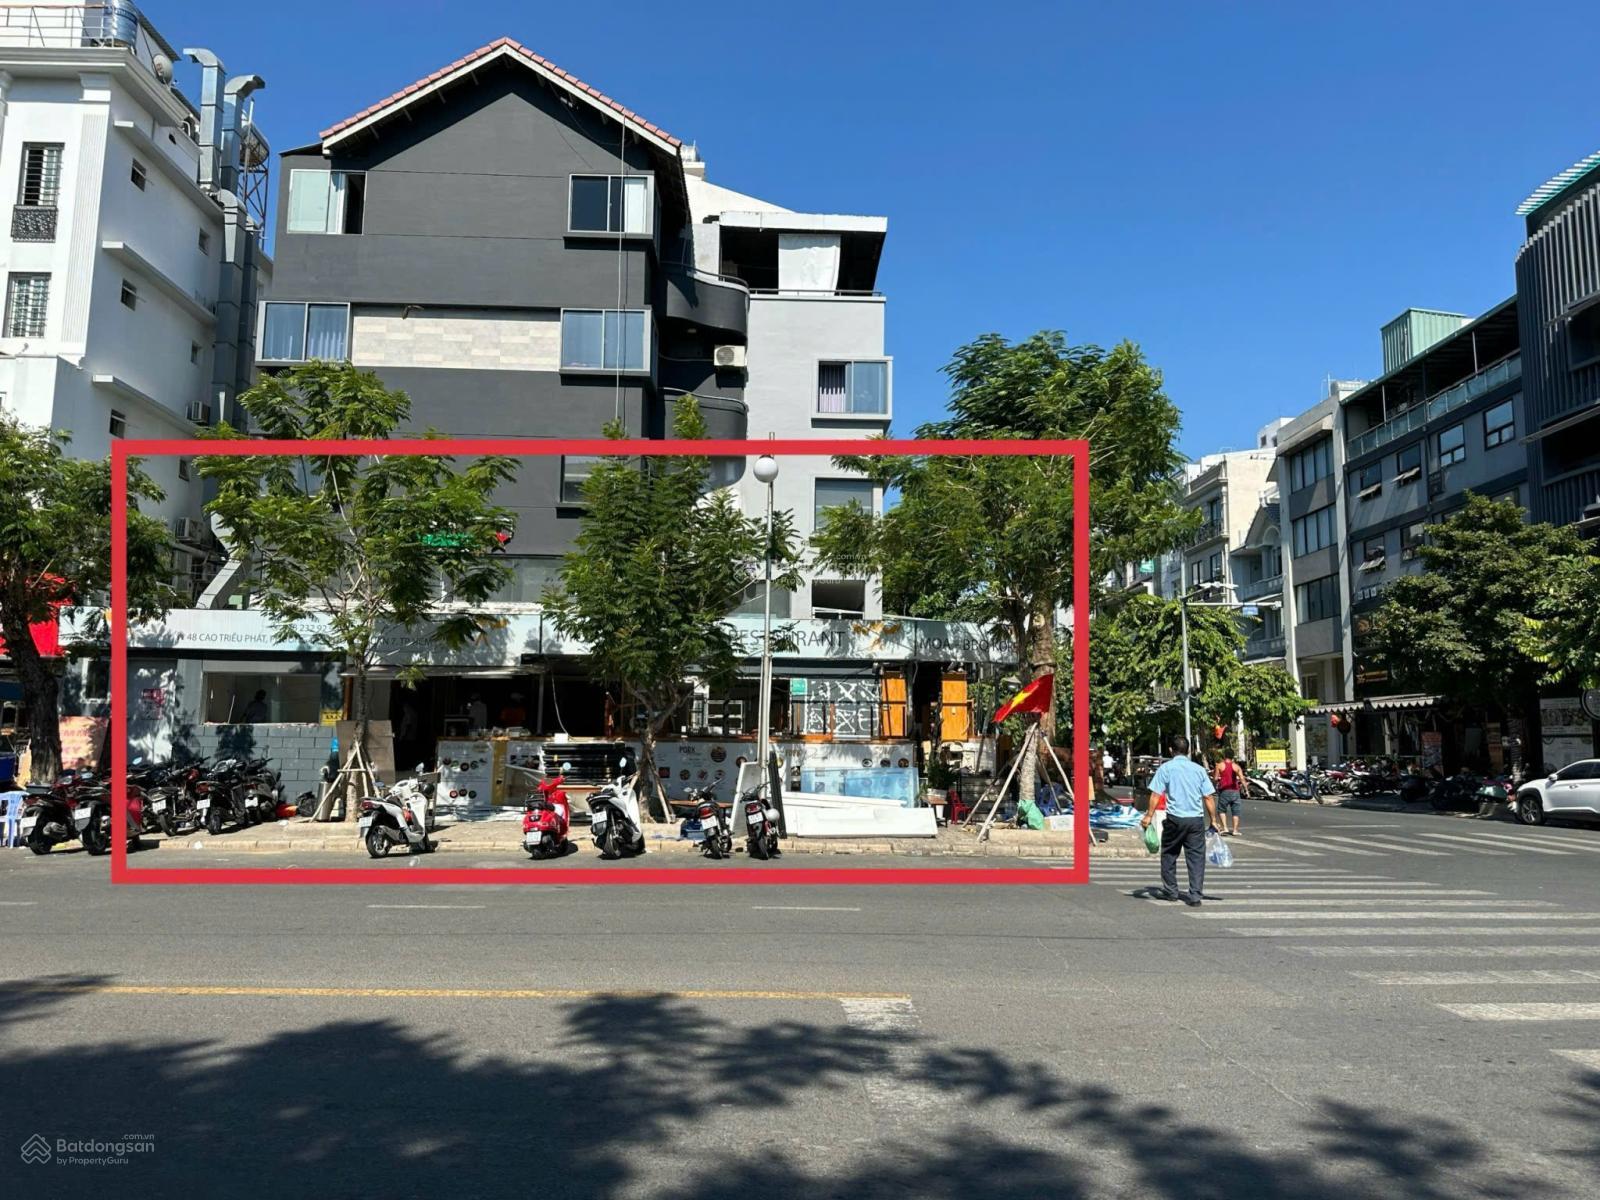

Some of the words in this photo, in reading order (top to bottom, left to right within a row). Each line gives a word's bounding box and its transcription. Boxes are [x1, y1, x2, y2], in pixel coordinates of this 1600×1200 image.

[186, 633, 198, 642] 48
[199, 633, 218, 642] CAO
[729, 629, 847, 648] RESURANT
[919, 638, 951, 651] MOA
[963, 639, 989, 652] BBQ
